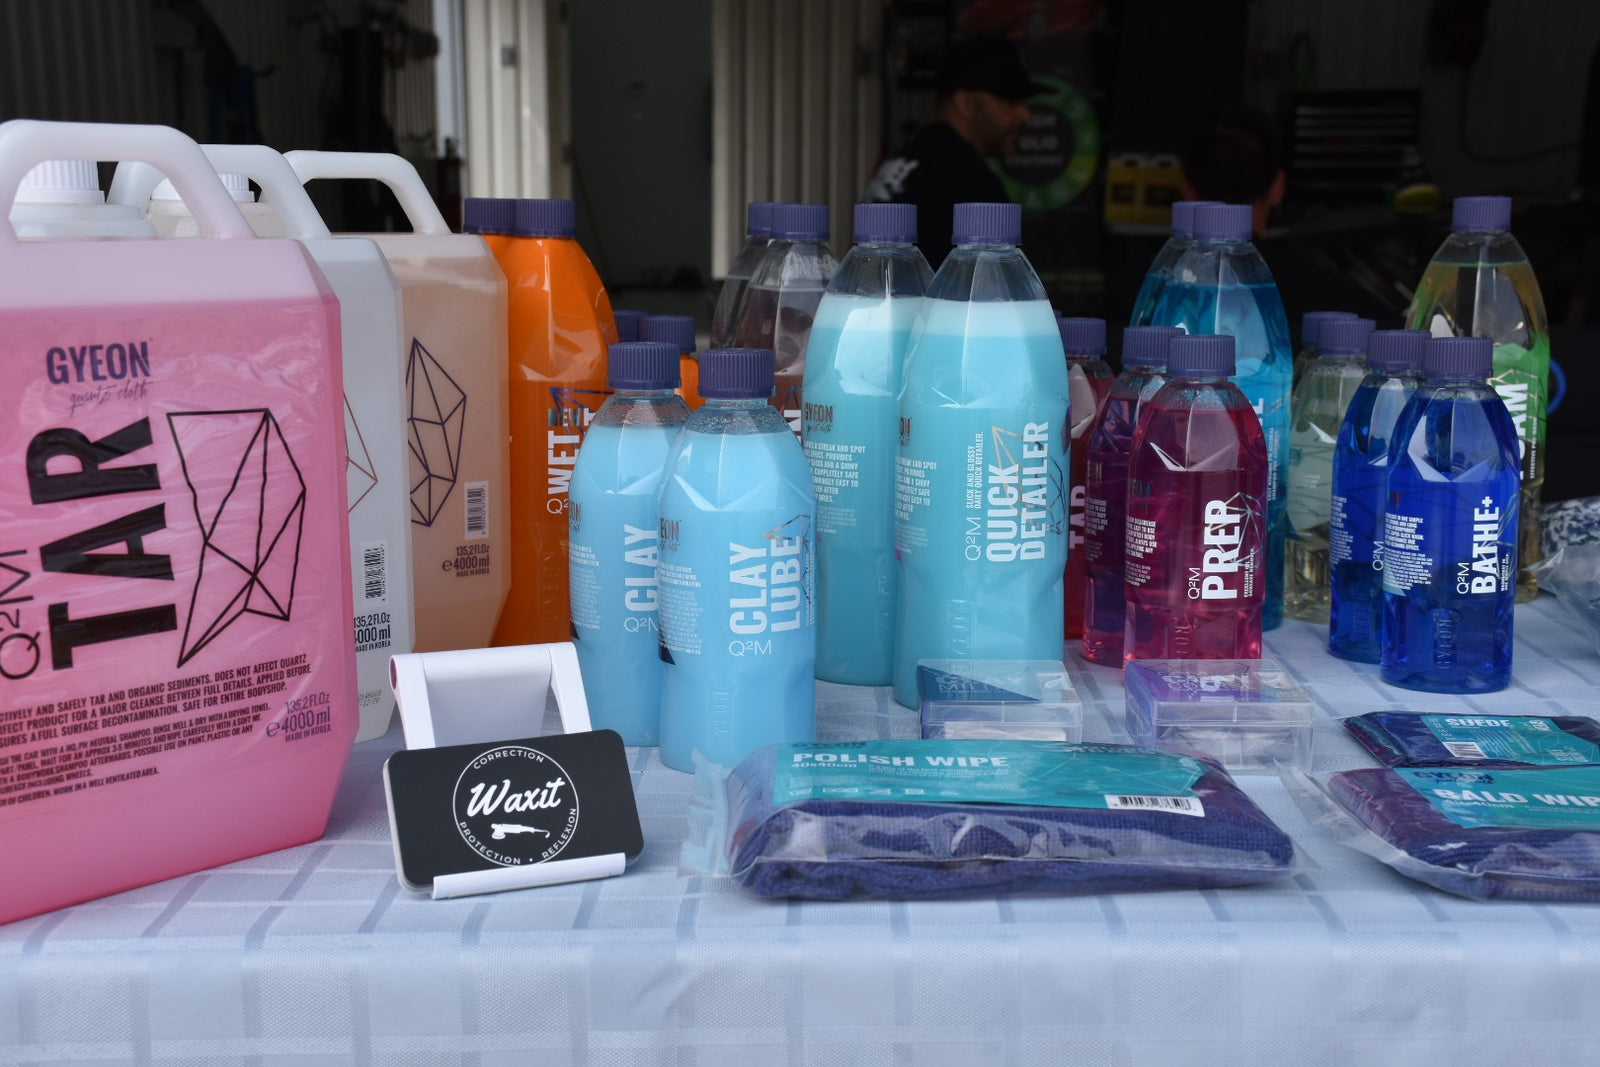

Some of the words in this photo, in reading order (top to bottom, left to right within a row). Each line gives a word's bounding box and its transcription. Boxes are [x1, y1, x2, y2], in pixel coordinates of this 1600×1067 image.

[46, 342, 151, 384] GYEON
[548, 430, 580, 494] WET
[826, 452, 852, 462] PROVIDES
[850, 446, 866, 454] SPOT
[967, 445, 976, 472] GLOSSY
[975, 432, 984, 466] DETAILER.
[840, 462, 859, 470] SHINY
[844, 471, 859, 479] SAFE
[966, 473, 975, 487] AND
[974, 466, 984, 488] QUICK
[836, 479, 849, 487] EASY
[851, 480, 859, 488] TO
[1020, 421, 1049, 560] DETAILER
[966, 489, 975, 509] SLICK
[974, 489, 983, 509] DAILY
[986, 464, 1021, 562] QUICK
[26, 416, 178, 671] TAR
[1202, 500, 1240, 600] PREP
[1470, 496, 1500, 594] BATHE+
[453, 556, 478, 570] 4000
[479, 554, 490, 567] ml
[624, 524, 659, 612] CLAY
[729, 541, 768, 636] CLAY
[770, 536, 801, 632] LUBE
[379, 624, 390, 640] ml
[27, 714, 68, 730] PRODUCT
[72, 710, 88, 722] FOR
[90, 708, 96, 718] A
[100, 702, 128, 716] MAJOR
[130, 695, 164, 710] CLEANSE
[167, 688, 201, 703] BETWEEN
[204, 684, 220, 696] FULL
[223, 678, 254, 692] DETAILS.
[256, 670, 284, 685] APPLIED
[286, 664, 312, 678] BEFORE
[36, 704, 54, 715] AND
[58, 698, 86, 712] SAFELY
[90, 694, 105, 706] TAR
[108, 690, 126, 702] AND
[128, 683, 165, 698] ORGANIC
[168, 674, 212, 691] SEDIMENTS.
[214, 670, 234, 682] DOES
[236, 666, 251, 677] NOT
[253, 660, 278, 674] AFFECT
[280, 654, 307, 668] QUARTZ
[30, 732, 36, 742] A
[38, 728, 58, 740] FULL
[61, 720, 98, 736] SURFACE
[102, 704, 180, 728] DECONTAMINATION.
[182, 700, 201, 712] SAFE
[204, 696, 218, 708] FOR
[220, 690, 246, 704] ENTIRE
[248, 682, 288, 698] BODYSHOP.
[316, 706, 331, 724] ml
[1445, 718, 1511, 727] SUEDE
[24, 750, 38, 760] CAR
[40, 746, 58, 757] WITH
[90, 734, 117, 747] NEUTRAL
[153, 724, 171, 734] RINSE
[172, 720, 187, 730] WELL
[188, 719, 194, 727] &
[195, 717, 207, 726] DRY
[208, 713, 222, 723] WITH
[224, 712, 228, 720] A
[228, 706, 250, 718] DRYING
[59, 754, 72, 763] FOR
[74, 752, 83, 760] AN
[85, 746, 110, 758] APPROX
[124, 736, 150, 749] MINUTES
[154, 734, 166, 744] AND
[167, 732, 182, 742] WIPE
[183, 725, 215, 738] CAREFULLY
[217, 722, 231, 732] WITH
[238, 716, 250, 726] SOFT
[285, 731, 303, 742] MADE
[304, 730, 310, 738] IN
[310, 724, 332, 736] KOREA
[17, 768, 54, 781] BODYWORK
[55, 760, 88, 774] SHAMPOO
[134, 746, 162, 757] POSSIBLE
[164, 742, 176, 750] USE
[178, 740, 187, 748] ON
[188, 736, 206, 746] PAINT,
[207, 729, 230, 742] PLASTIC
[232, 728, 240, 736] OR
[242, 725, 254, 734] ANY
[473, 749, 544, 770] CORRECTION
[792, 753, 916, 766] POLISH
[925, 756, 1010, 768] WIPE
[27, 774, 64, 788] INCLUDING
[54, 785, 74, 795] WORK
[75, 784, 81, 792] IN
[82, 782, 87, 790] A
[89, 778, 104, 788] WELL
[106, 770, 142, 784] VENTILATED
[1432, 788, 1528, 803] BALD
[466, 777, 566, 816] Waxit
[459, 821, 521, 864] PROTECTION
[542, 808, 577, 860] REFLEXION
